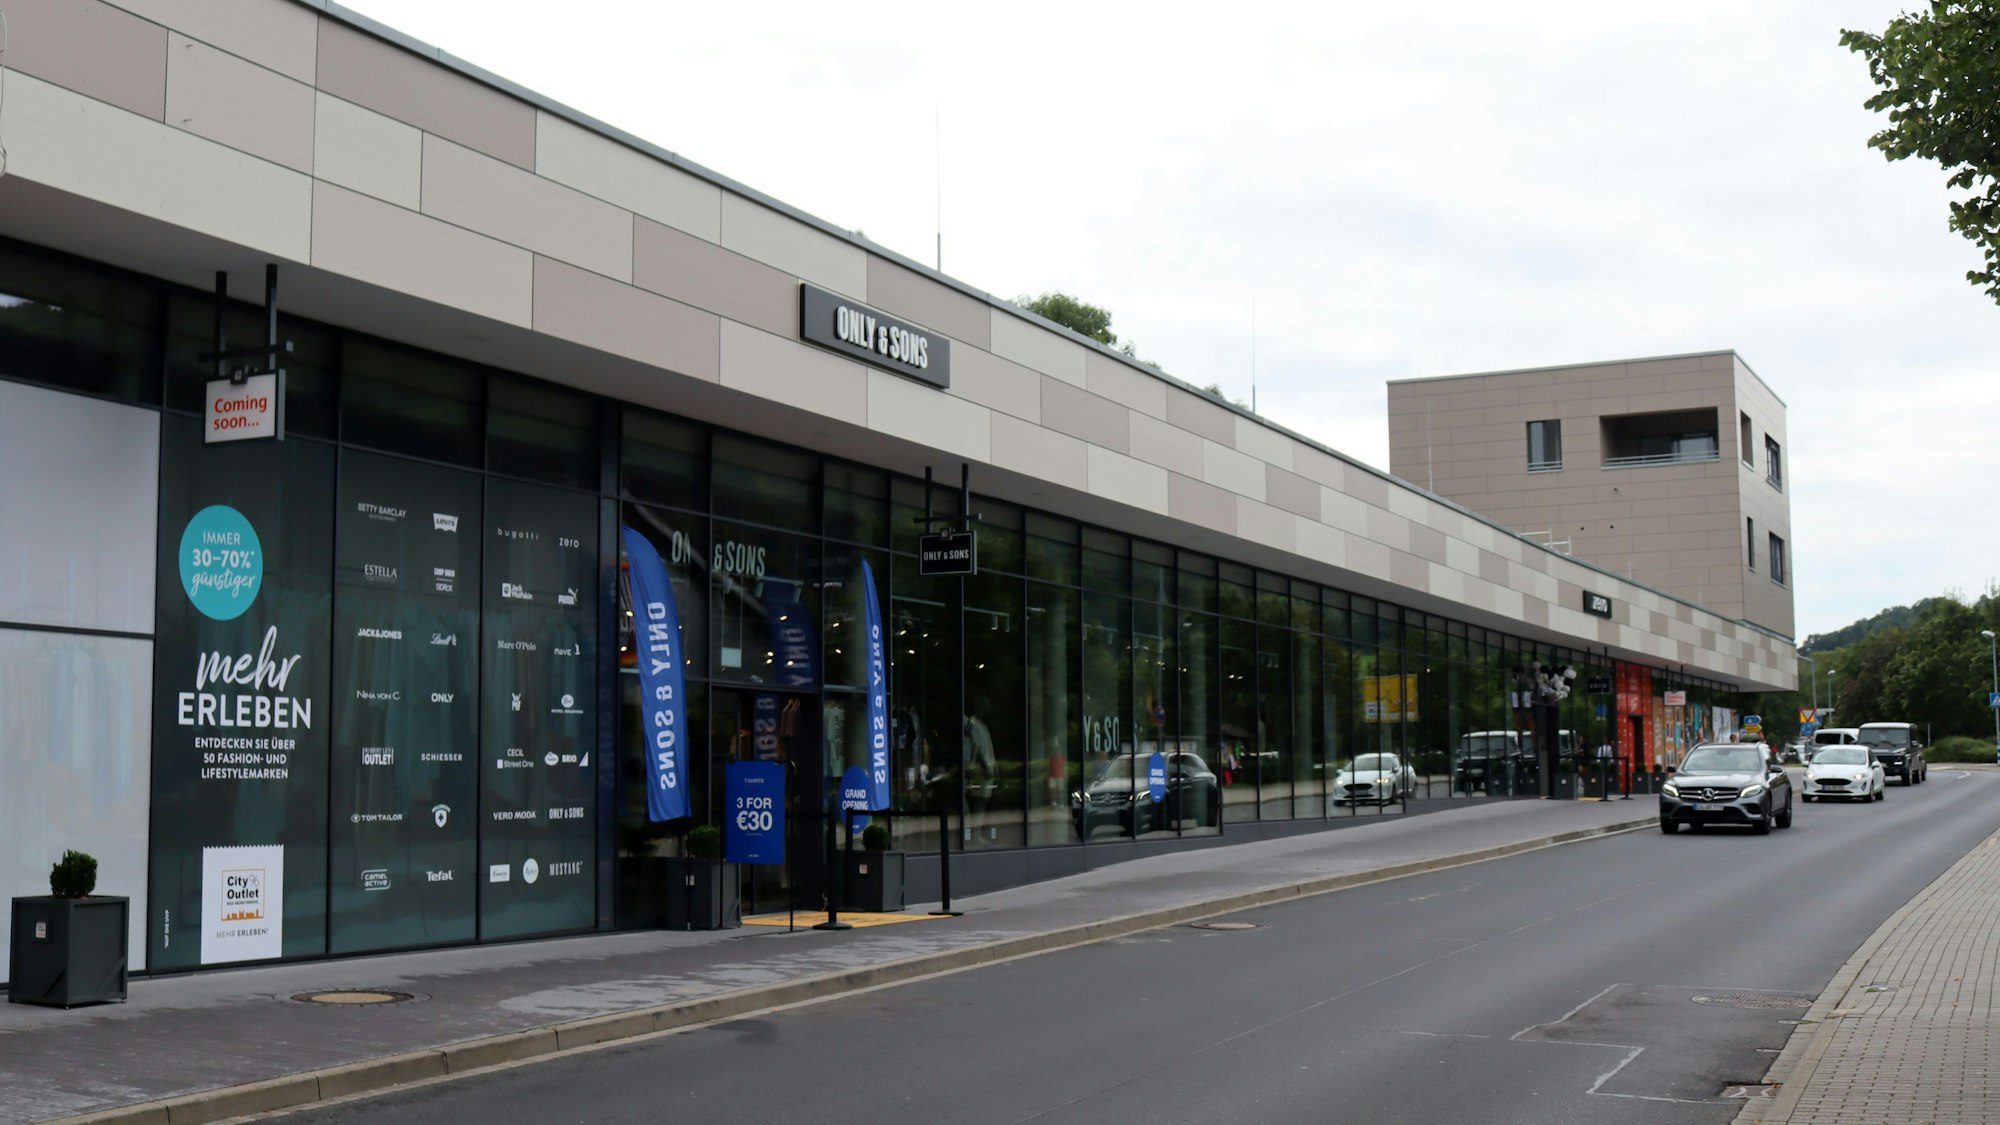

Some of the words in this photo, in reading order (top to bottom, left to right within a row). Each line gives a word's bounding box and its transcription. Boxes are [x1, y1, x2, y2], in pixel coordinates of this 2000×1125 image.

[836, 306, 876, 350] ONLY
[878, 326, 888, 355] &
[889, 325, 928, 369] SONS
[214, 395, 267, 413] Coming
[214, 416, 259, 430] soon...
[358, 502, 378, 513] BETTY
[378, 505, 407, 518] BARCLAY
[203, 531, 241, 545] IMMER
[498, 527, 539, 540] bugatti
[559, 537, 580, 548] zero
[714, 543, 722, 570] &
[725, 540, 766, 577] SONS
[923, 551, 942, 561] ONLY
[949, 549, 969, 559] SONS
[364, 564, 398, 579] ESTELLA
[192, 569, 256, 598] günstiger
[357, 628, 402, 640] JACK&JONES
[497, 640, 514, 650] Marc
[515, 640, 536, 651] O'Polo
[196, 625, 301, 692] mehr
[392, 691, 401, 701] C
[431, 692, 454, 703] ONLY
[178, 692, 312, 729] ERLEBEN
[1093, 721, 1101, 752] &
[195, 737, 252, 749] ENTDECKEN
[255, 738, 269, 750] SIE
[271, 736, 296, 750] ÜBER
[421, 752, 463, 762] SCHIESSER
[507, 748, 524, 757] CECIL
[561, 754, 577, 763] BRIO
[203, 753, 215, 764] 50
[218, 753, 264, 764] FASHION-
[265, 754, 287, 765] UND
[364, 753, 392, 766] OUTLET
[504, 760, 522, 768] Street
[522, 760, 534, 768] One
[201, 768, 289, 780] LIFESTYLEMARKEN
[844, 788, 866, 799] GRAND
[736, 797, 744, 809] 3
[746, 797, 772, 810] FOR
[361, 814, 378, 822] TOM
[377, 813, 403, 821] TAILOR
[493, 811, 513, 820] VERO
[513, 811, 536, 820] MODA
[549, 808, 563, 819] ONLY
[569, 807, 584, 819] SONS
[736, 810, 773, 831] €30
[426, 870, 453, 881] Tefal
[227, 876, 249, 888] City
[227, 888, 259, 900] Outlet
[216, 930, 236, 939] MEHR
[237, 928, 269, 937] ERLEBEN!
